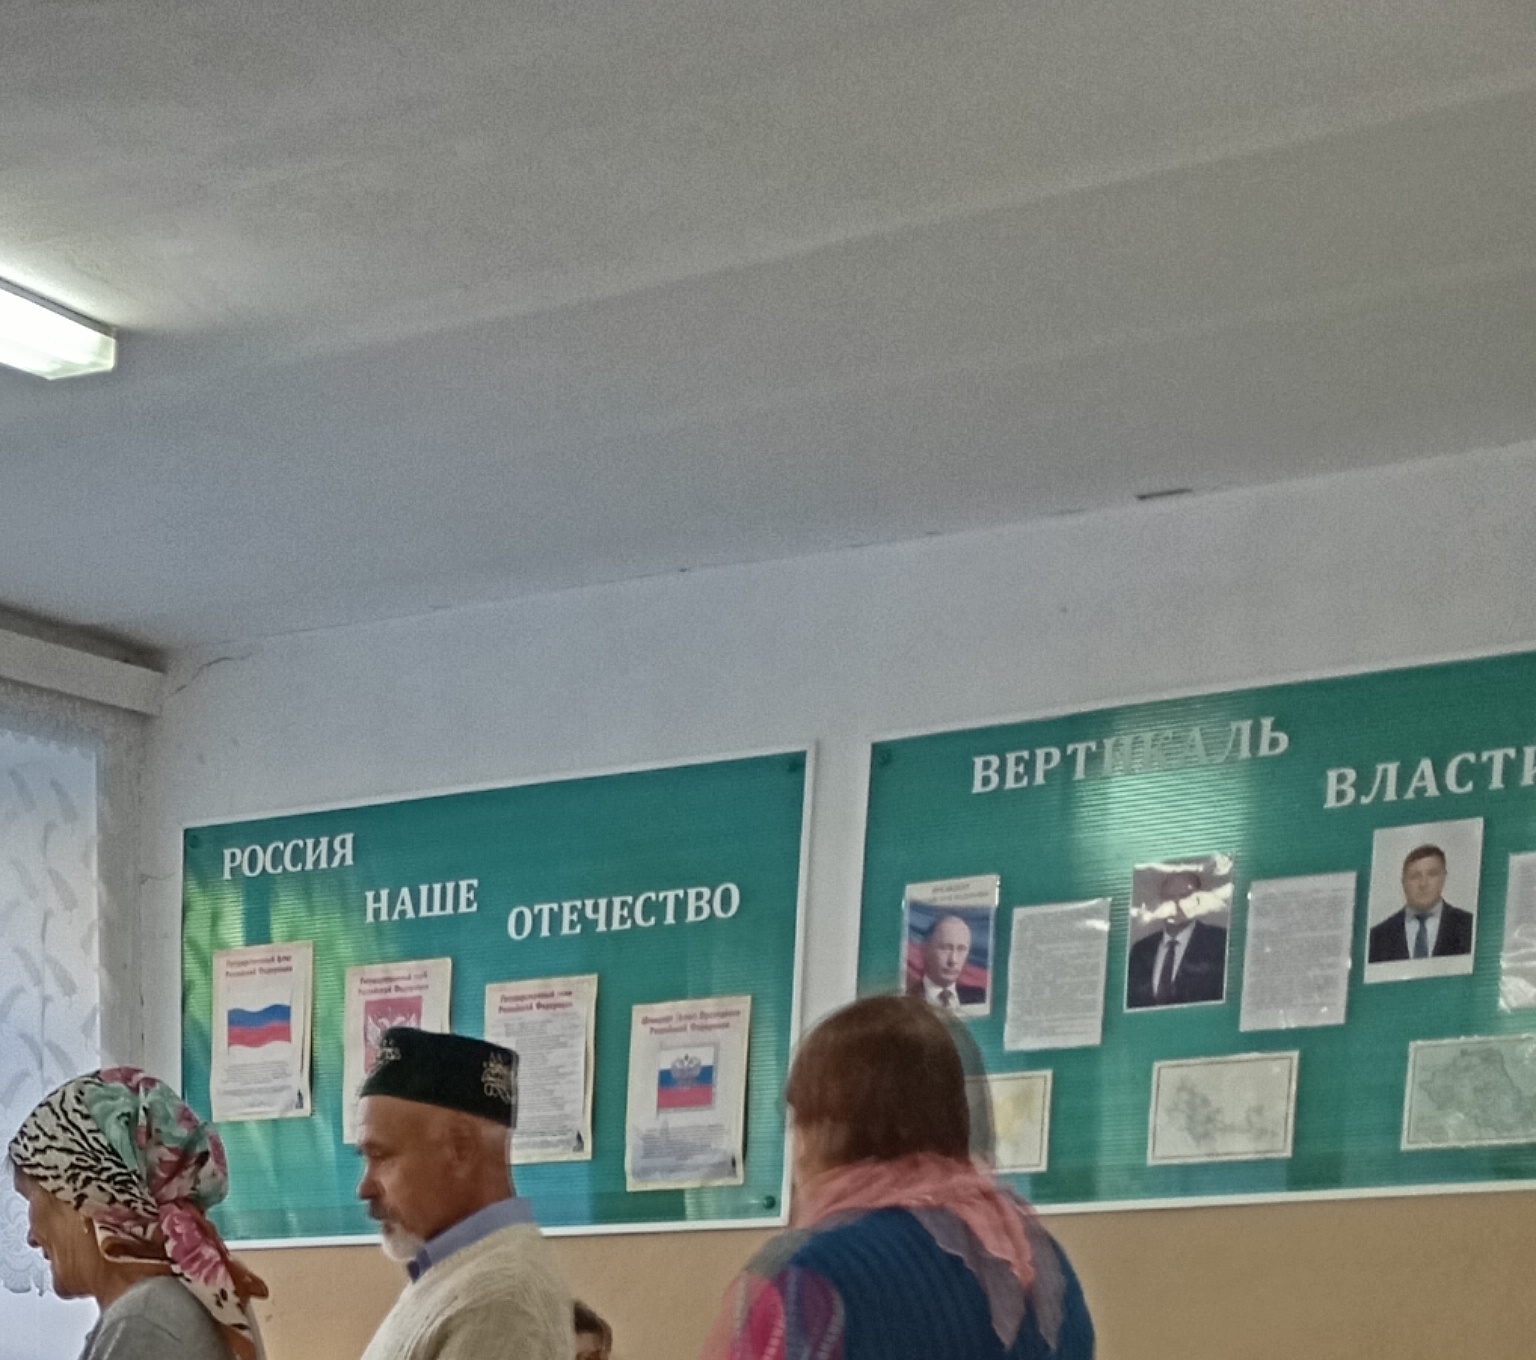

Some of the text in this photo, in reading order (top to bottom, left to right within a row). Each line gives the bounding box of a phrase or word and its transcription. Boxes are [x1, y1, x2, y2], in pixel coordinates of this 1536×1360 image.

[971, 716, 1290, 795] ВЕРТИКАЛЬ
[222, 832, 354, 880] РОССИЯ
[364, 878, 479, 923] НАШЕ
[506, 881, 741, 941] ОТЕЧЕСТВО
